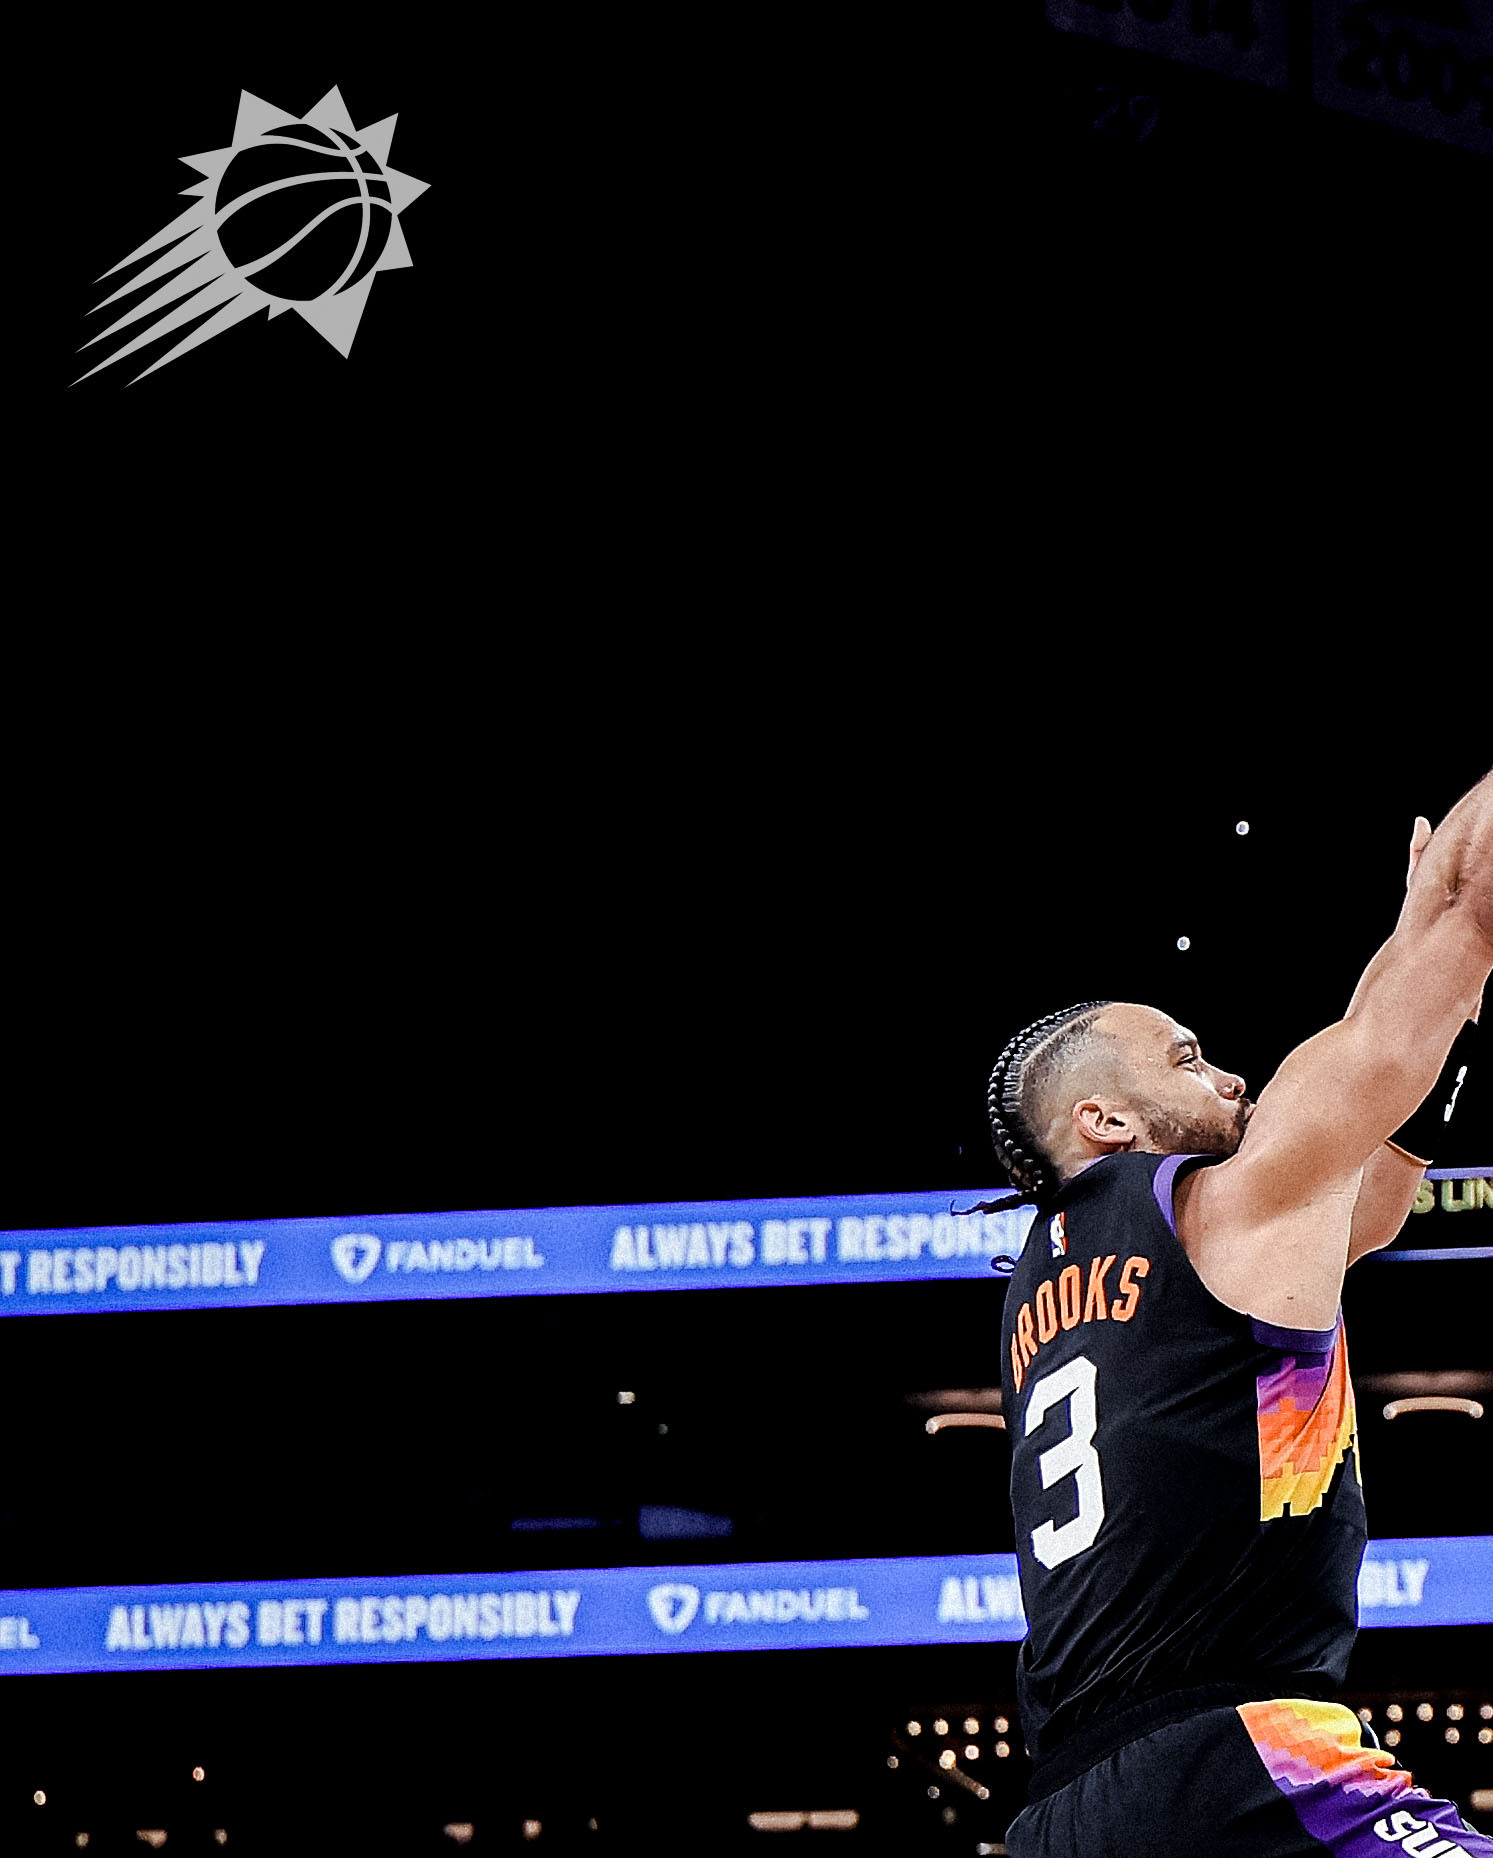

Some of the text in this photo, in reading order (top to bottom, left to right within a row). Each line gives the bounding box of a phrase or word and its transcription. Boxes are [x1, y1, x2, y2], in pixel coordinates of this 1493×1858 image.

[26, 1240, 266, 1294] RESPONSIBLY
[385, 1237, 544, 1272] FANDUEL
[610, 1220, 755, 1271] ALWAYS
[760, 1216, 832, 1268] BET
[1011, 1255, 1150, 1394] BROOKS
[1025, 1356, 1104, 1570] 3
[105, 1590, 581, 1652] ALWAYS BET RESPONSIBLY
[705, 1587, 869, 1625] FANDUEL
